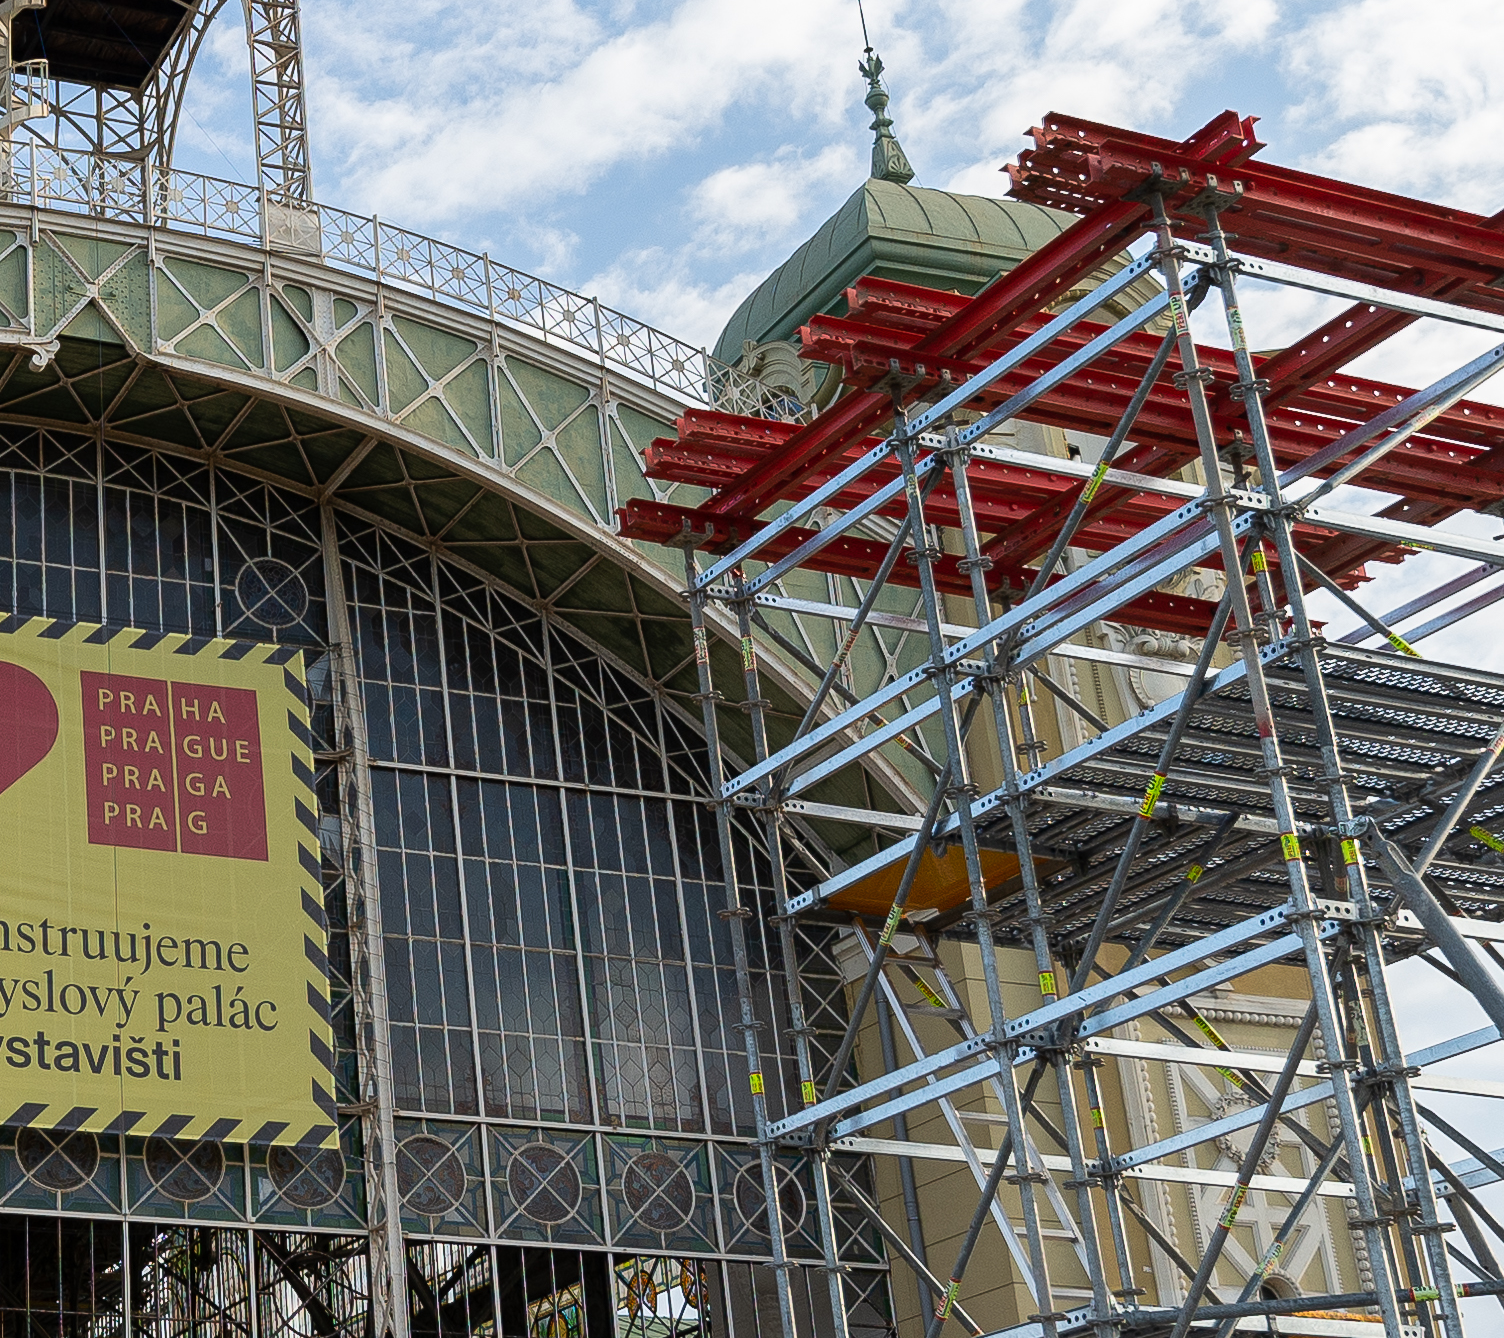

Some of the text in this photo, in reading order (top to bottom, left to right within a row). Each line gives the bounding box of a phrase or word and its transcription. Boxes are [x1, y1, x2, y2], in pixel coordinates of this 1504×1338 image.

[1173, 296, 1187, 330] PERI UP
[155, 986, 278, 1032] palác
